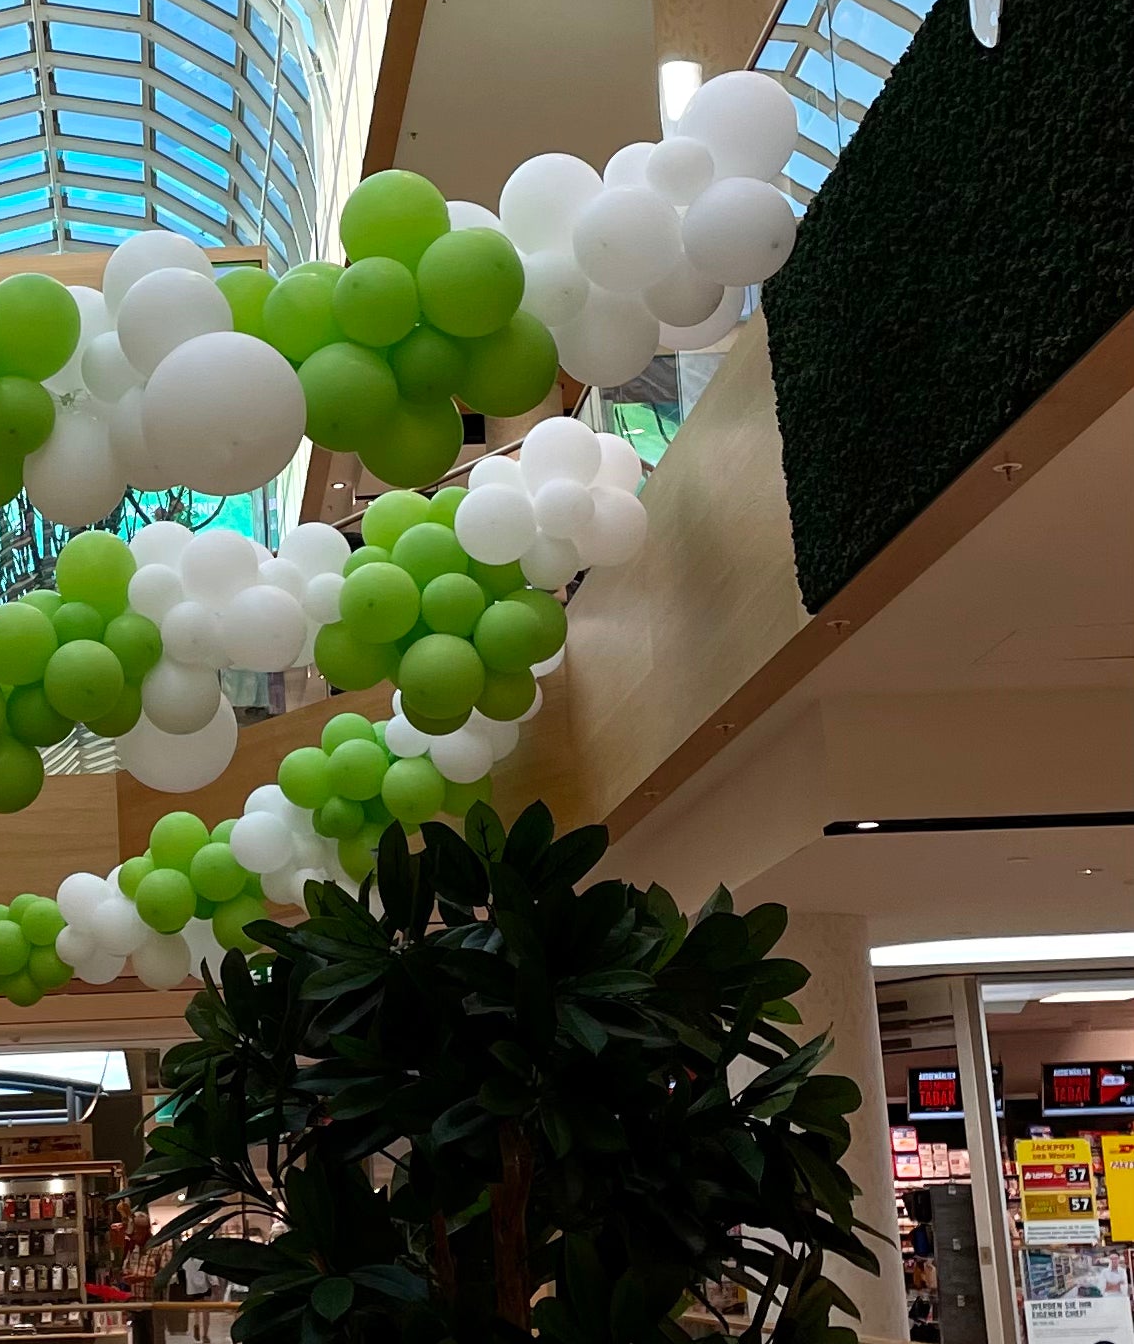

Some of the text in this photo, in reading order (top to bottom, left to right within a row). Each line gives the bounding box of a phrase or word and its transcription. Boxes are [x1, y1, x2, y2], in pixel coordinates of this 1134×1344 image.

[919, 1090, 956, 1106] TABAK
[1054, 1087, 1091, 1102] TABAK
[1031, 1143, 1075, 1151] JACKPOTS
[1068, 1168, 1087, 1182] 37
[1071, 1198, 1090, 1211] 57
[1031, 1302, 1063, 1310] WERDEN
[1032, 1310, 1063, 1319] EIGENER
